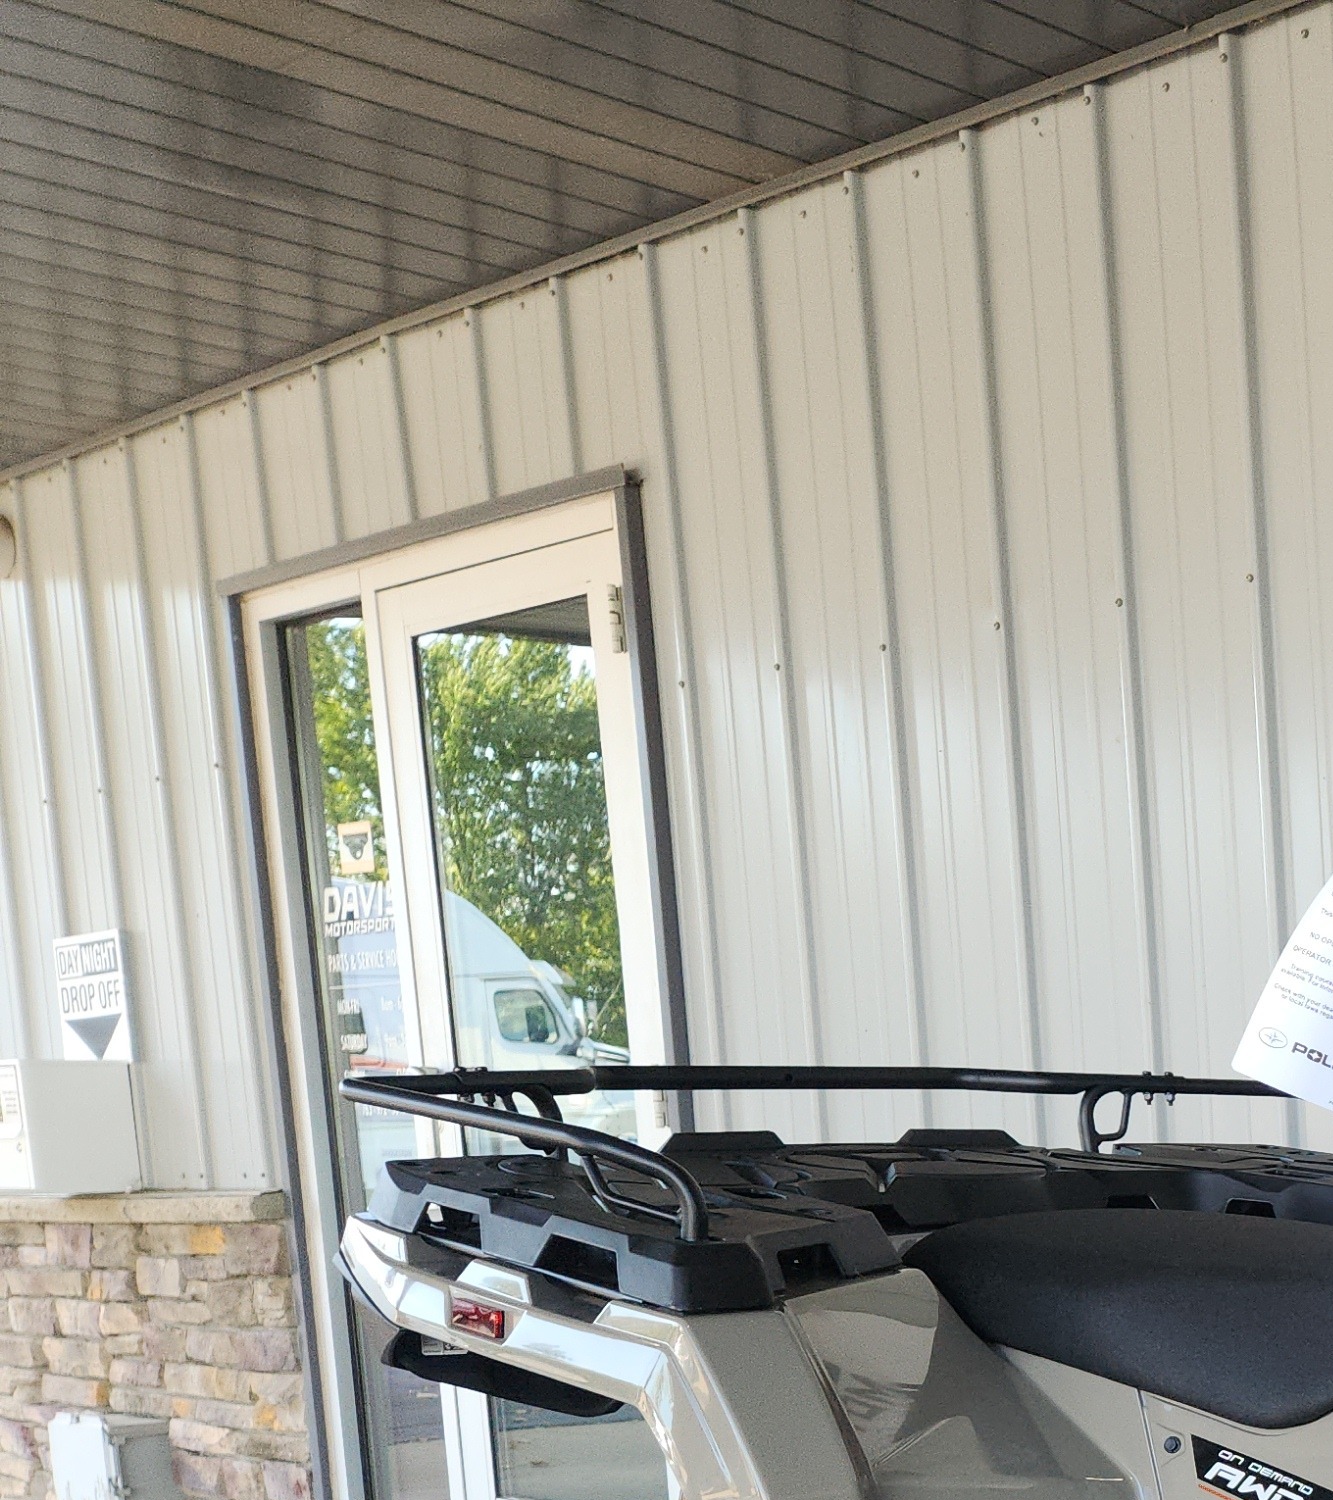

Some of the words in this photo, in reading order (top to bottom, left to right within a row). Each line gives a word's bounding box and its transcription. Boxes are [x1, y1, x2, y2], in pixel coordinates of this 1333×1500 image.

[59, 949, 79, 976] DAY
[80, 940, 115, 974] NIGHT
[61, 983, 95, 1014] DROP
[98, 979, 120, 1009] OFF
[1217, 1449, 1245, 1466] ON
[1247, 1462, 1314, 1496] DEMAND
